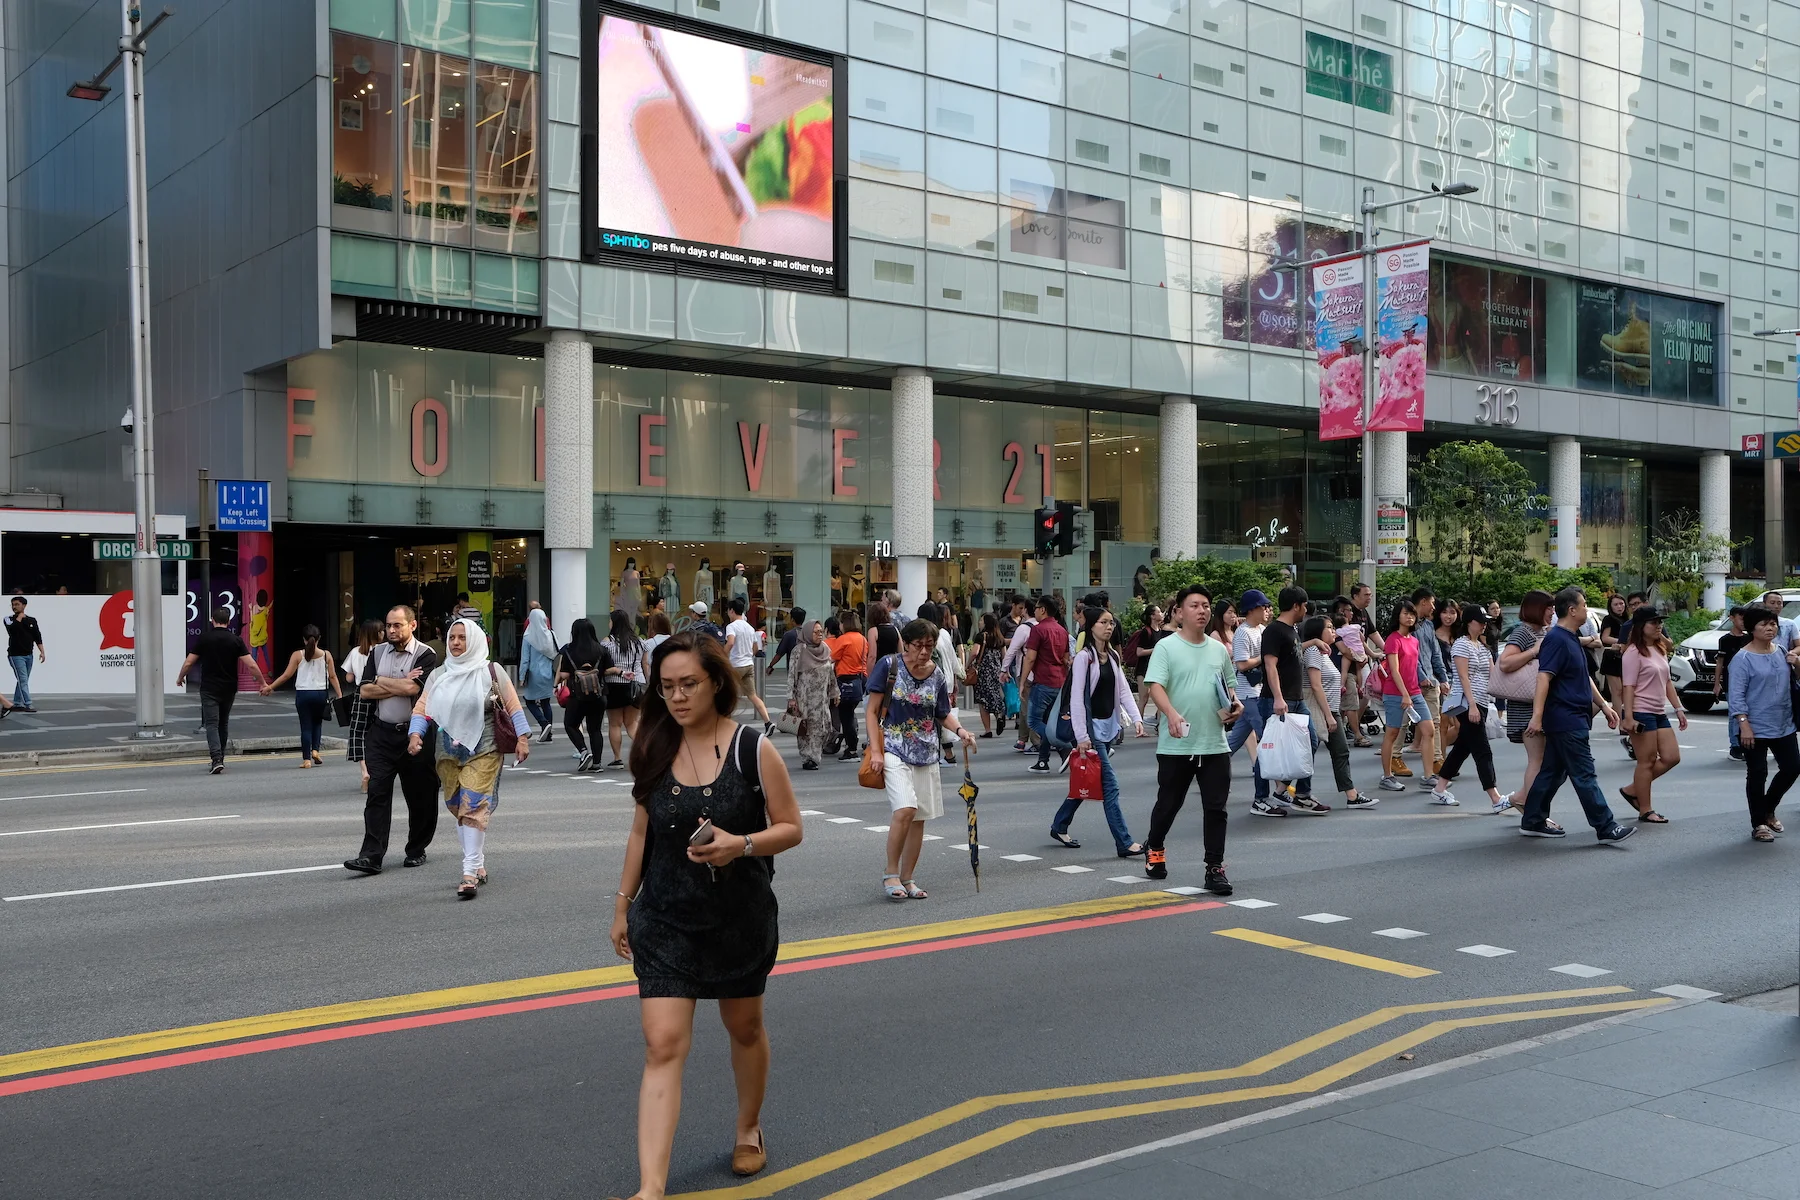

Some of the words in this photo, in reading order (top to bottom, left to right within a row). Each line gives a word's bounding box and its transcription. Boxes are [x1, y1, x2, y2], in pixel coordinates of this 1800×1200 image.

[652, 242, 668, 252] pes
[670, 243, 686, 254] five
[687, 246, 707, 258] days
[709, 249, 719, 258] of
[719, 250, 747, 264] abuse,
[748, 256, 766, 267] rape
[772, 259, 788, 269] and
[789, 262, 810, 271] other
[811, 264, 824, 275] top
[1389, 259, 1399, 268] SG
[1324, 273, 1334, 282] SG
[1482, 301, 1520, 316] TOGETHER
[1522, 308, 1533, 317] WE
[1488, 314, 1528, 329] CELEBRATE
[1662, 322, 1677, 335] The
[1676, 318, 1712, 342] ORIGINAL
[1663, 339, 1692, 361] YELLOW
[1693, 344, 1713, 364] BOOT
[1475, 384, 1520, 427] 313
[1744, 450, 1761, 458] MRT
[228, 508, 243, 518] Keep
[246, 508, 259, 517] Left
[220, 516, 237, 525] While
[239, 517, 267, 527] Crossing
[173, 542, 191, 557] RD
[100, 653, 135, 661] SINGAPORE
[100, 660, 125, 668] VISITOR
